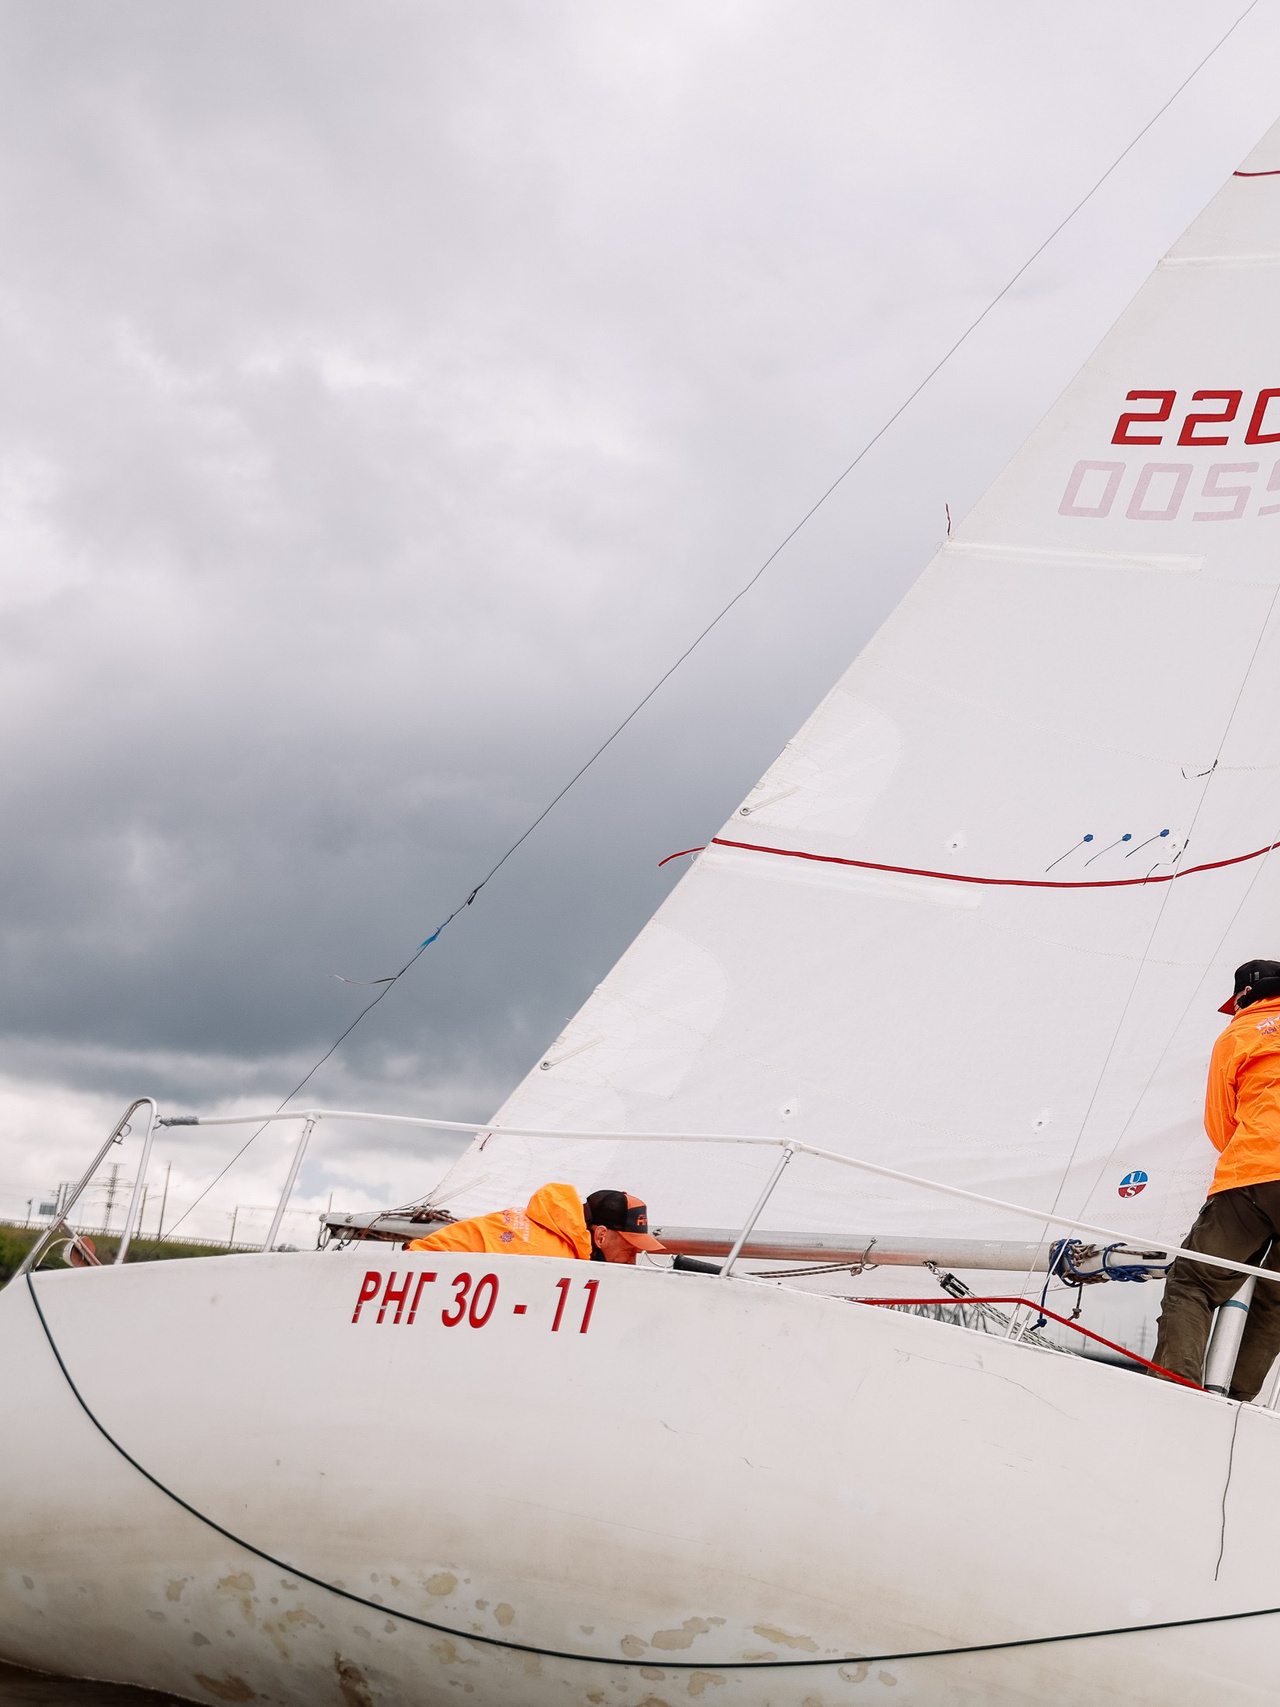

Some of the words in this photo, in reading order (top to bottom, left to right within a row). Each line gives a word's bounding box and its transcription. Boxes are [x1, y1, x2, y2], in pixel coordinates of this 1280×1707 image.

[352, 1271, 438, 1325] РНГ
[441, 1272, 500, 1329] 30
[551, 1277, 600, 1334] 11
